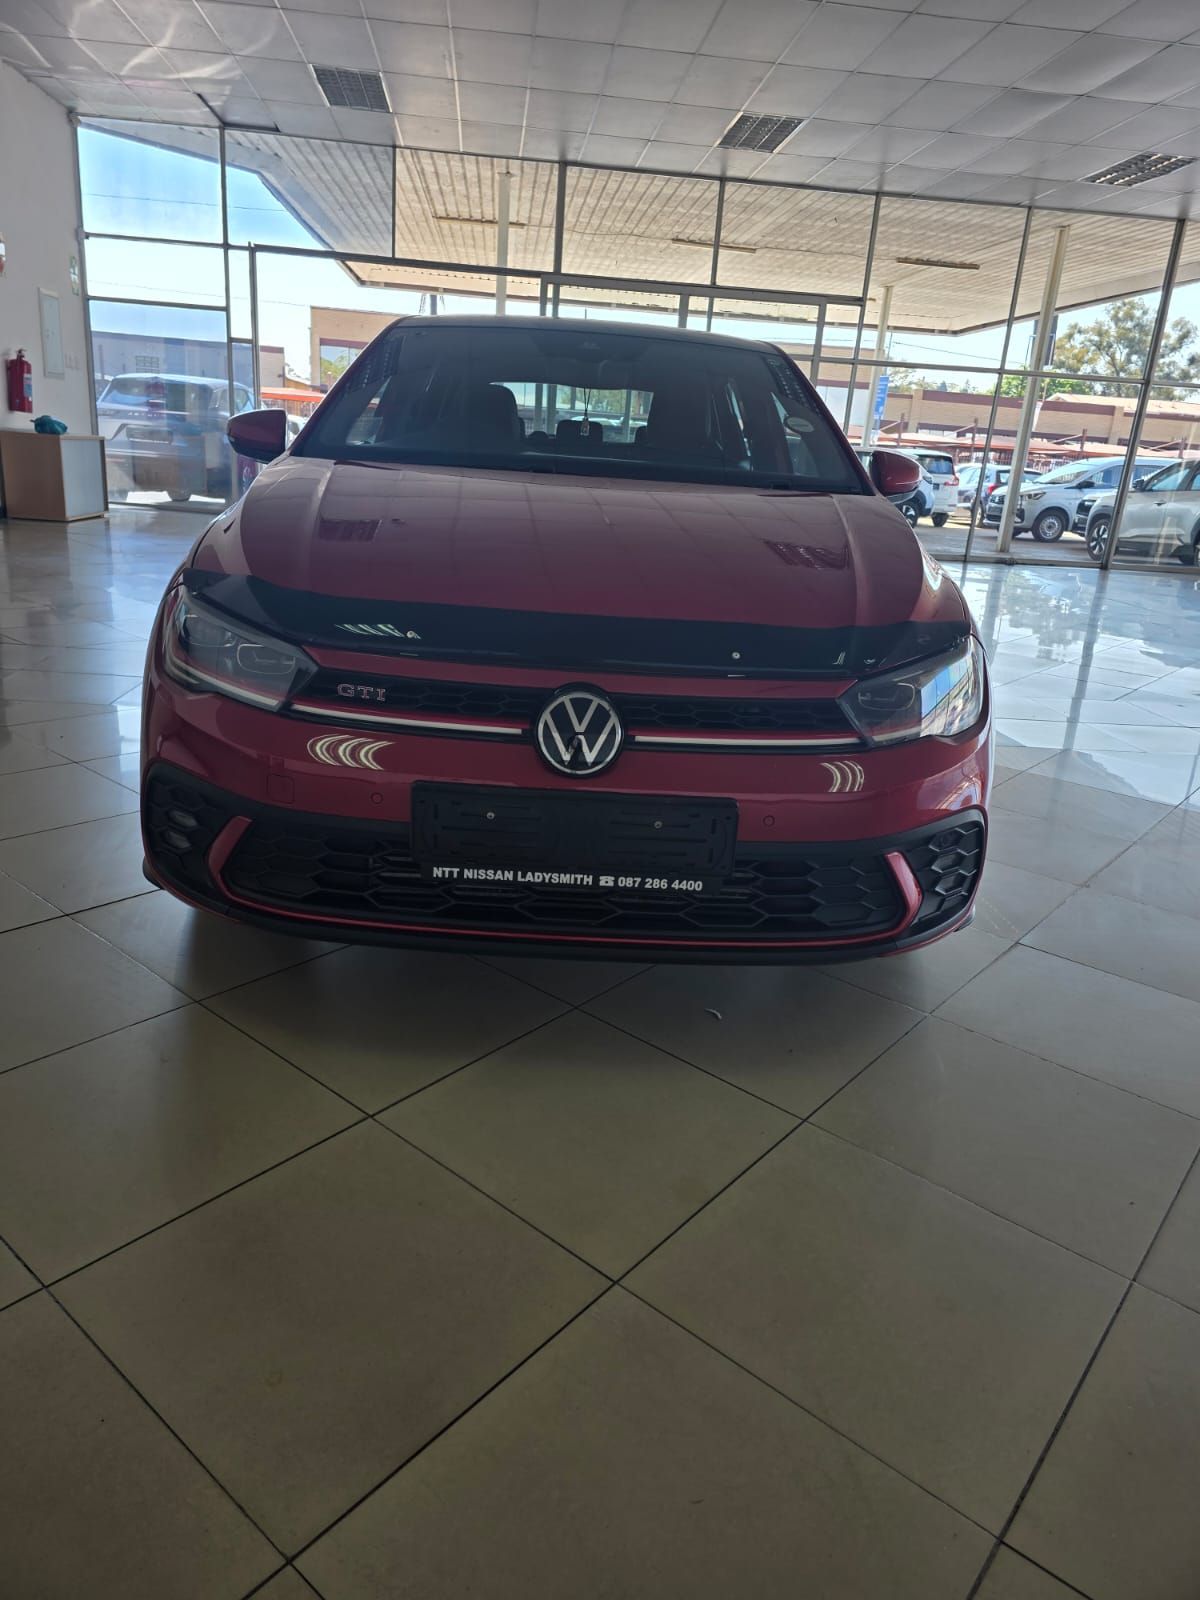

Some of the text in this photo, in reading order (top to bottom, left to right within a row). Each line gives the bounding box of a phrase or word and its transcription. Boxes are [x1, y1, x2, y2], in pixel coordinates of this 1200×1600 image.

[336, 682, 387, 702] GTI
[432, 866, 704, 892] NTT NISSAN LADYSMITH 087 286 4400
